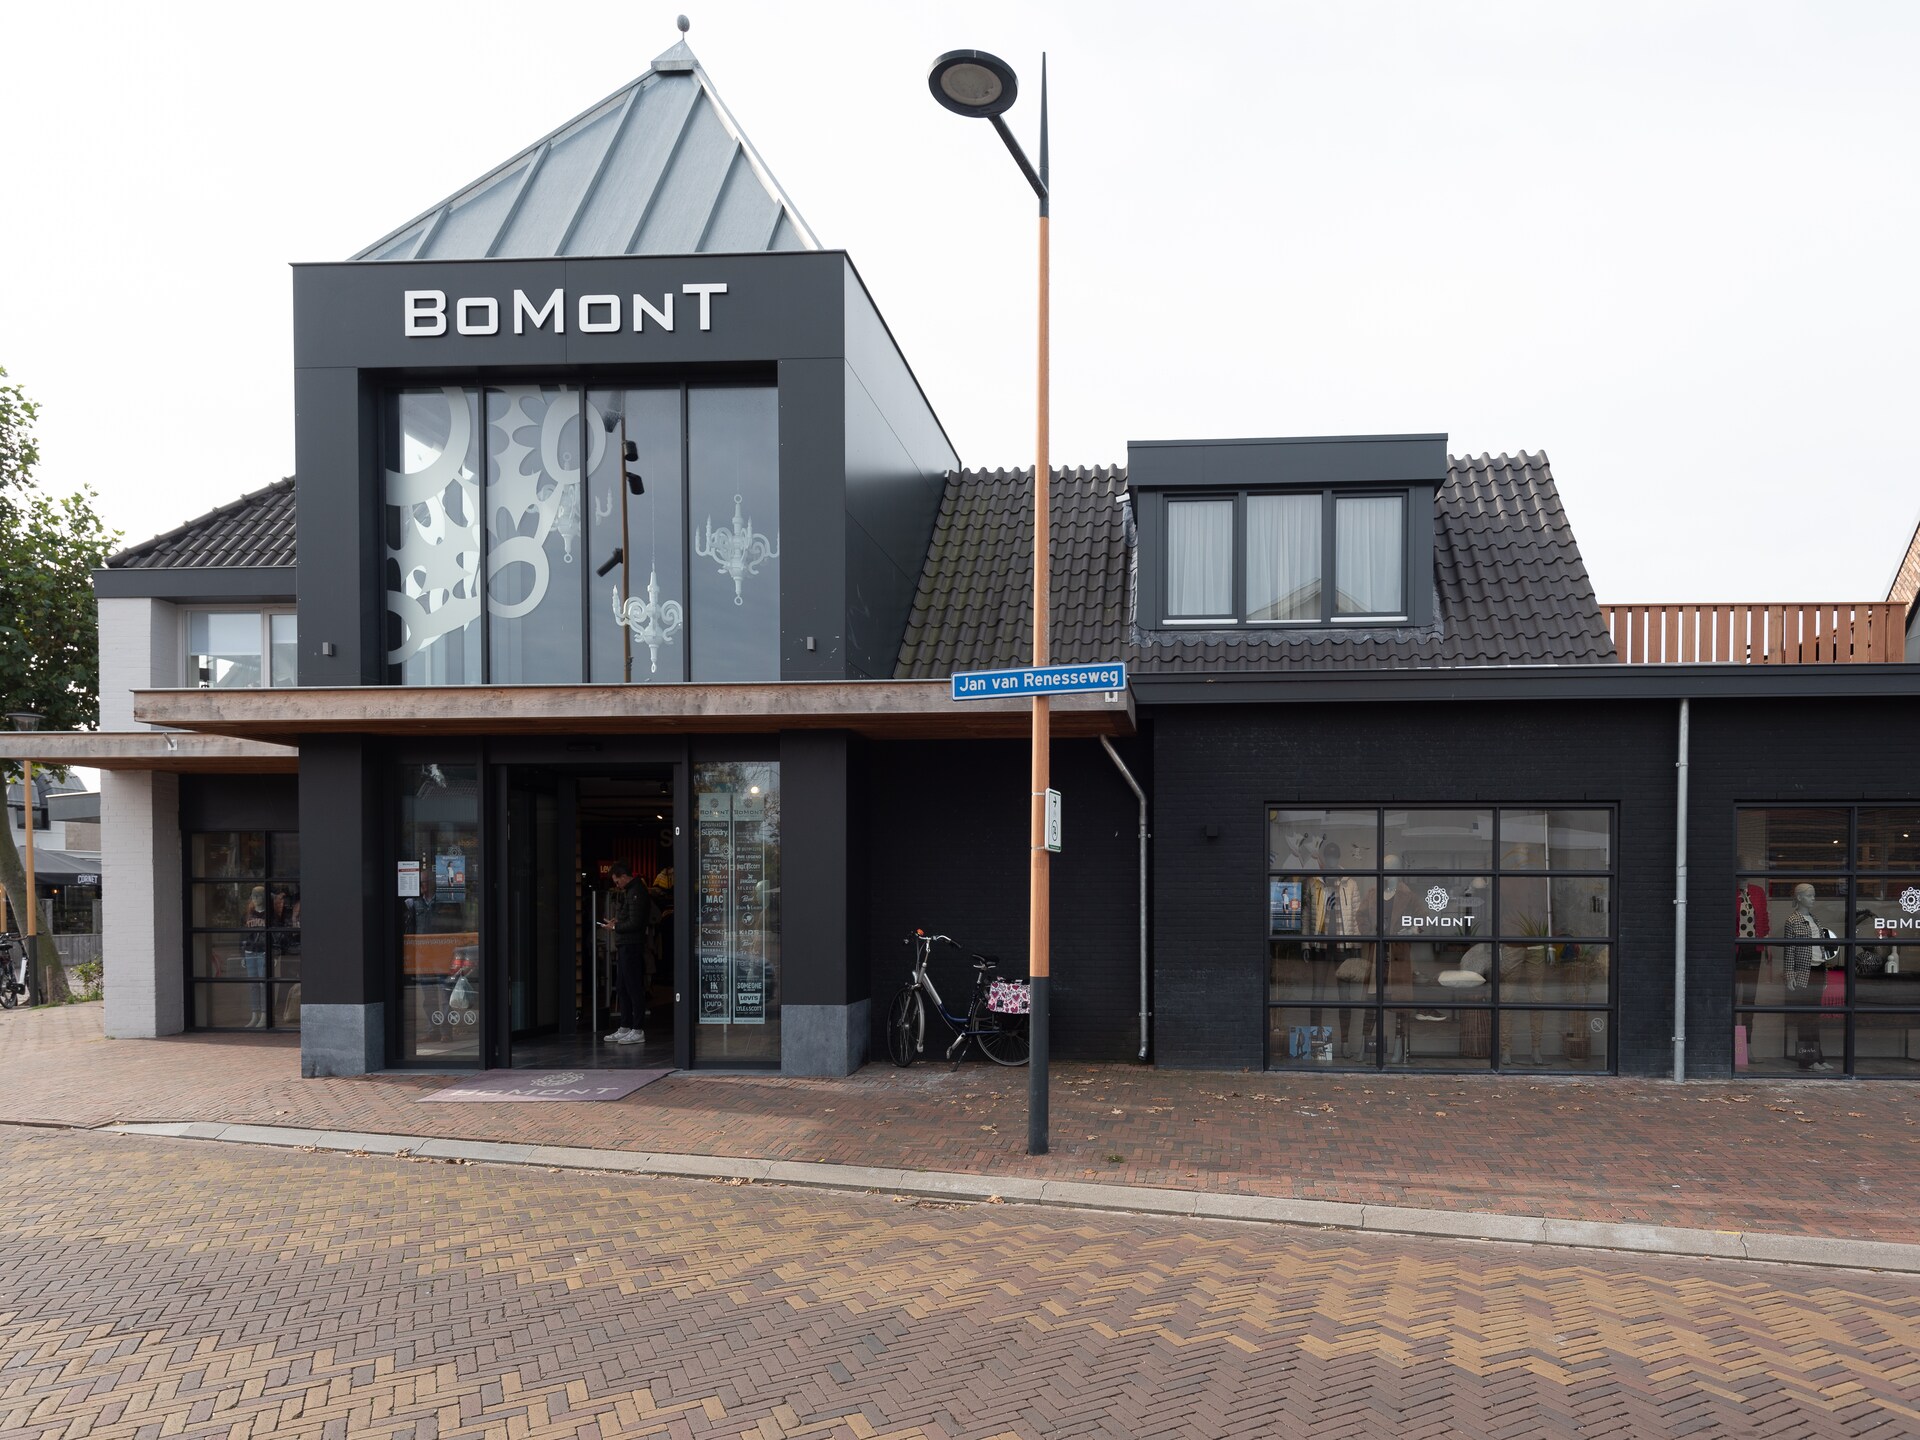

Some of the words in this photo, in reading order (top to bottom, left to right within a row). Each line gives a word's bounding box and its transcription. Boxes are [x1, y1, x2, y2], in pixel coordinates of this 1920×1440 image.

[404, 283, 728, 337] BOMONT
[959, 677, 986, 692] Jan
[992, 676, 1018, 690] van
[1023, 670, 1118, 687] Renesseweg
[706, 895, 724, 903] MAC
[1401, 915, 1475, 927] BOMONT
